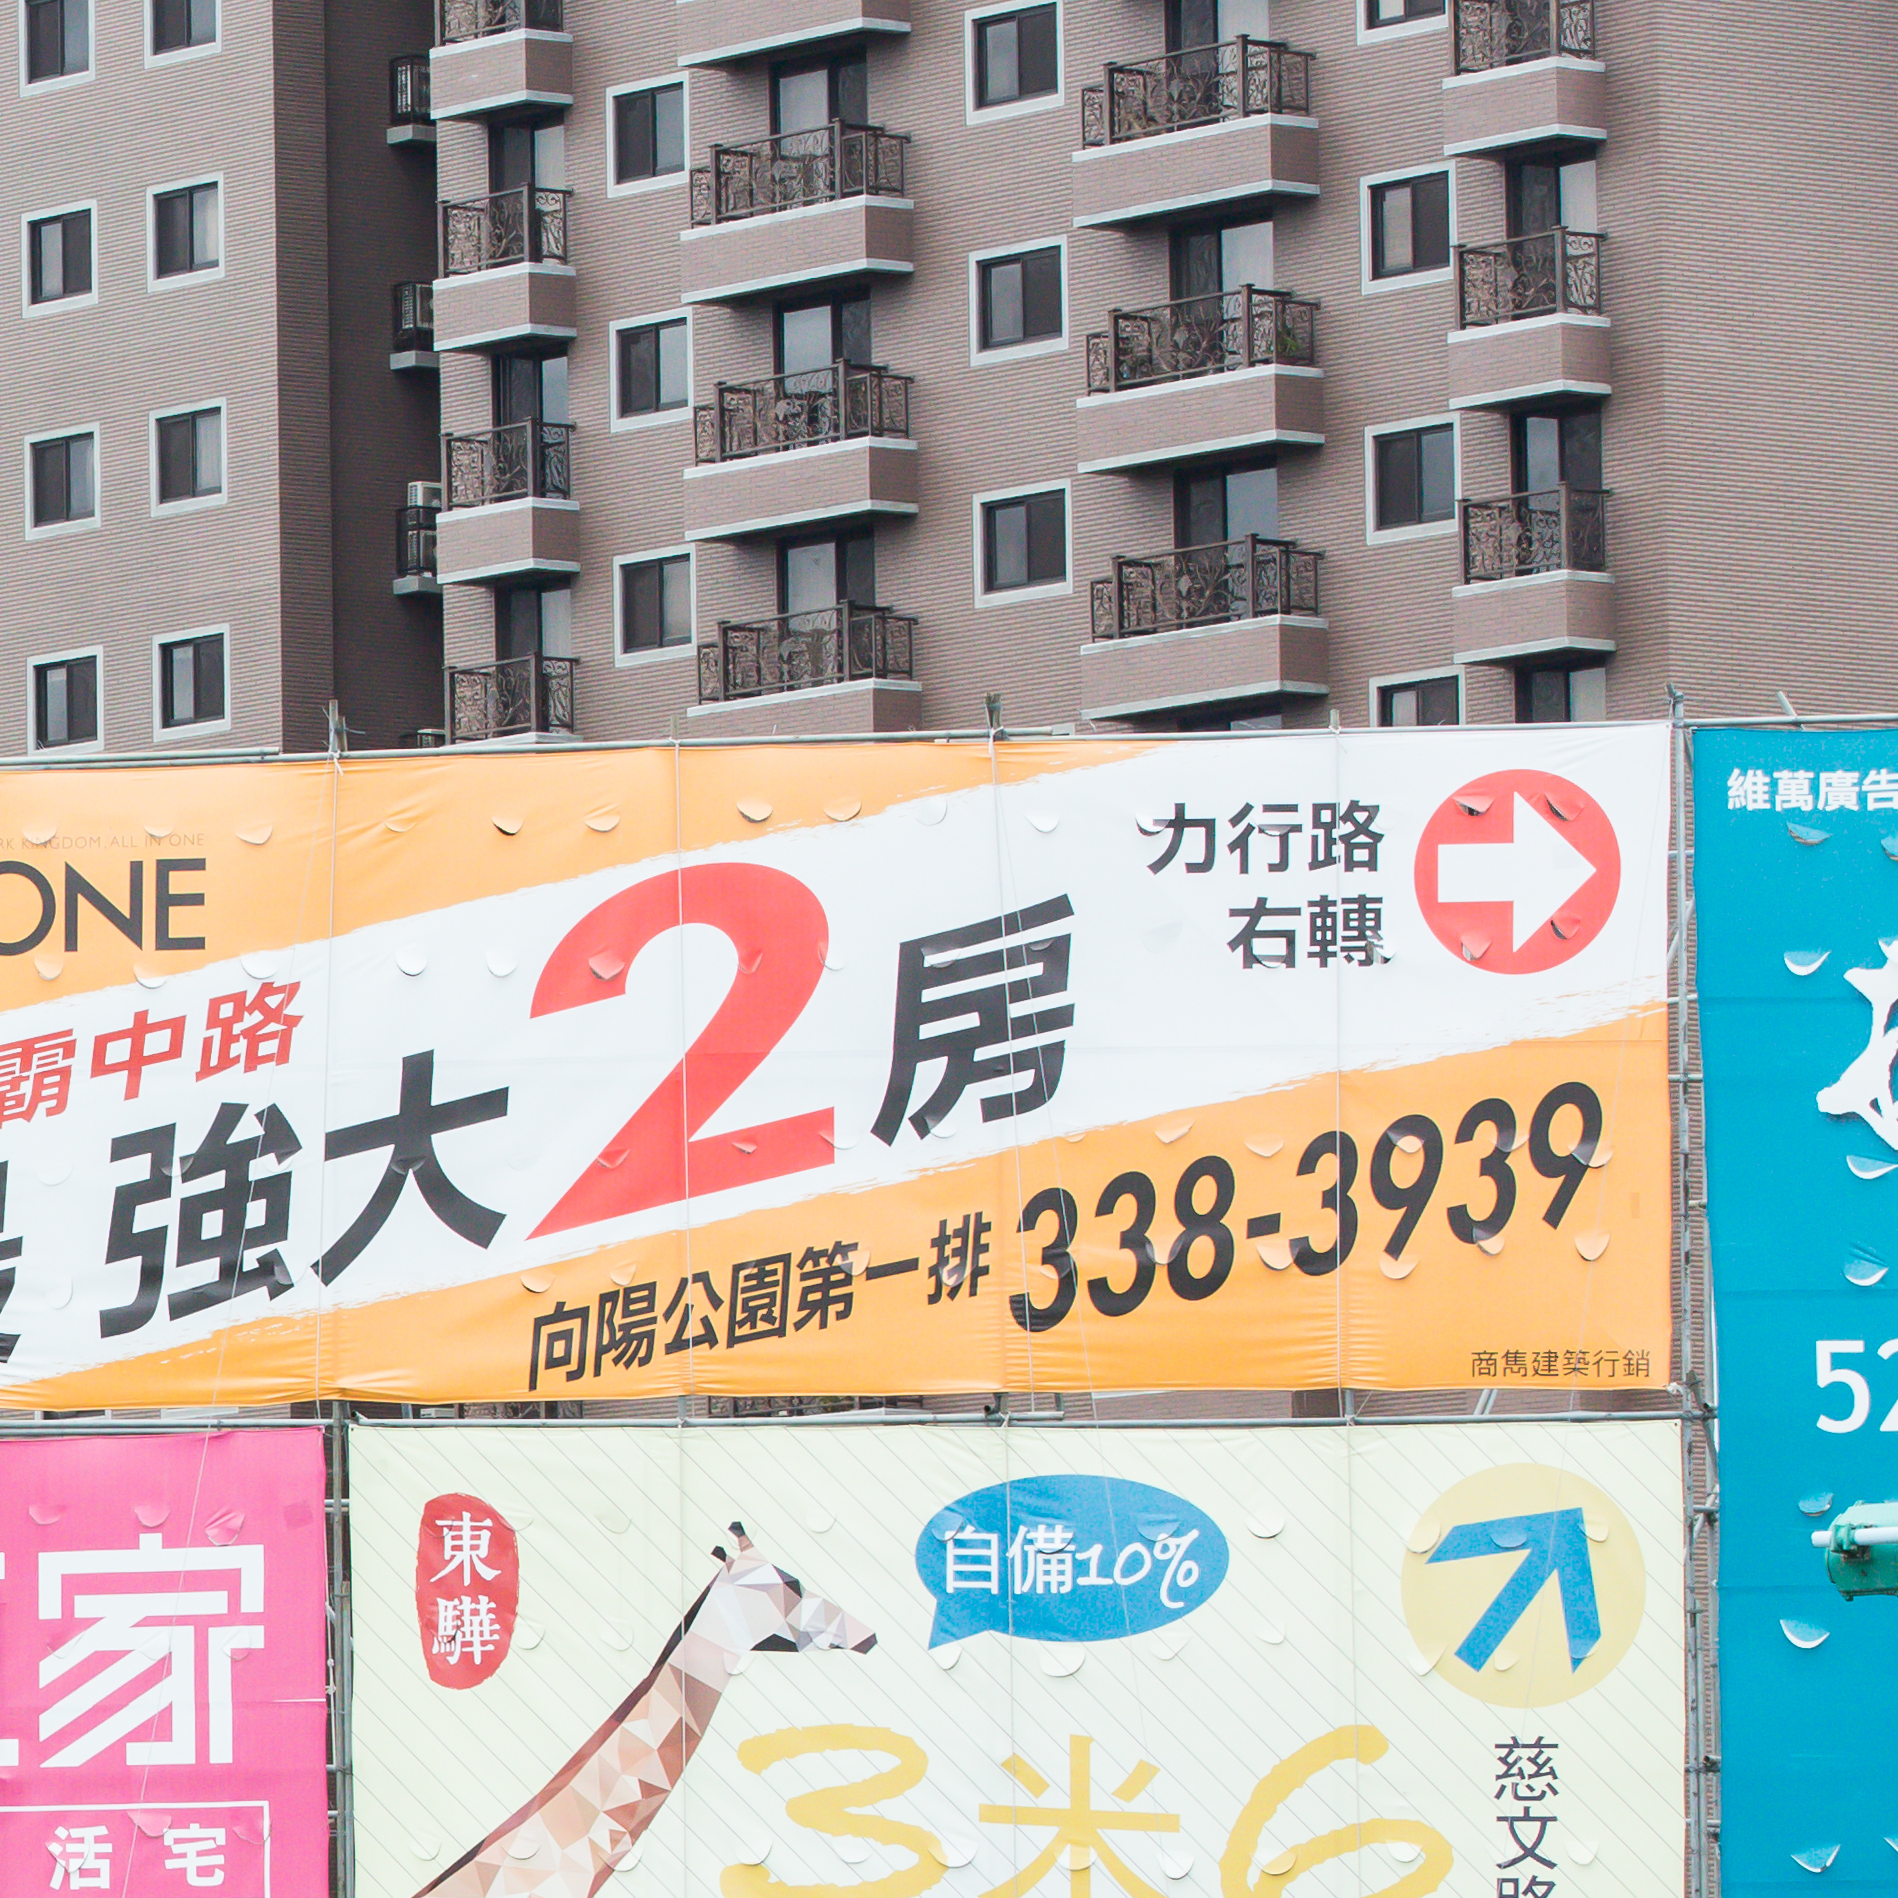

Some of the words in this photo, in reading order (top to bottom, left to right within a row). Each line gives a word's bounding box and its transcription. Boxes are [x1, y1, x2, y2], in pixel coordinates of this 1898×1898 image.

[1726, 767, 1898, 812] 維萬廣告
[1145, 801, 1385, 876] 力行路
[1225, 895, 1387, 970] 右轉
[526, 1210, 993, 1393] 向陽公園第一排
[1008, 1080, 1605, 1334] 338-3939
[944, 1522, 1201, 1609] 自備10%
